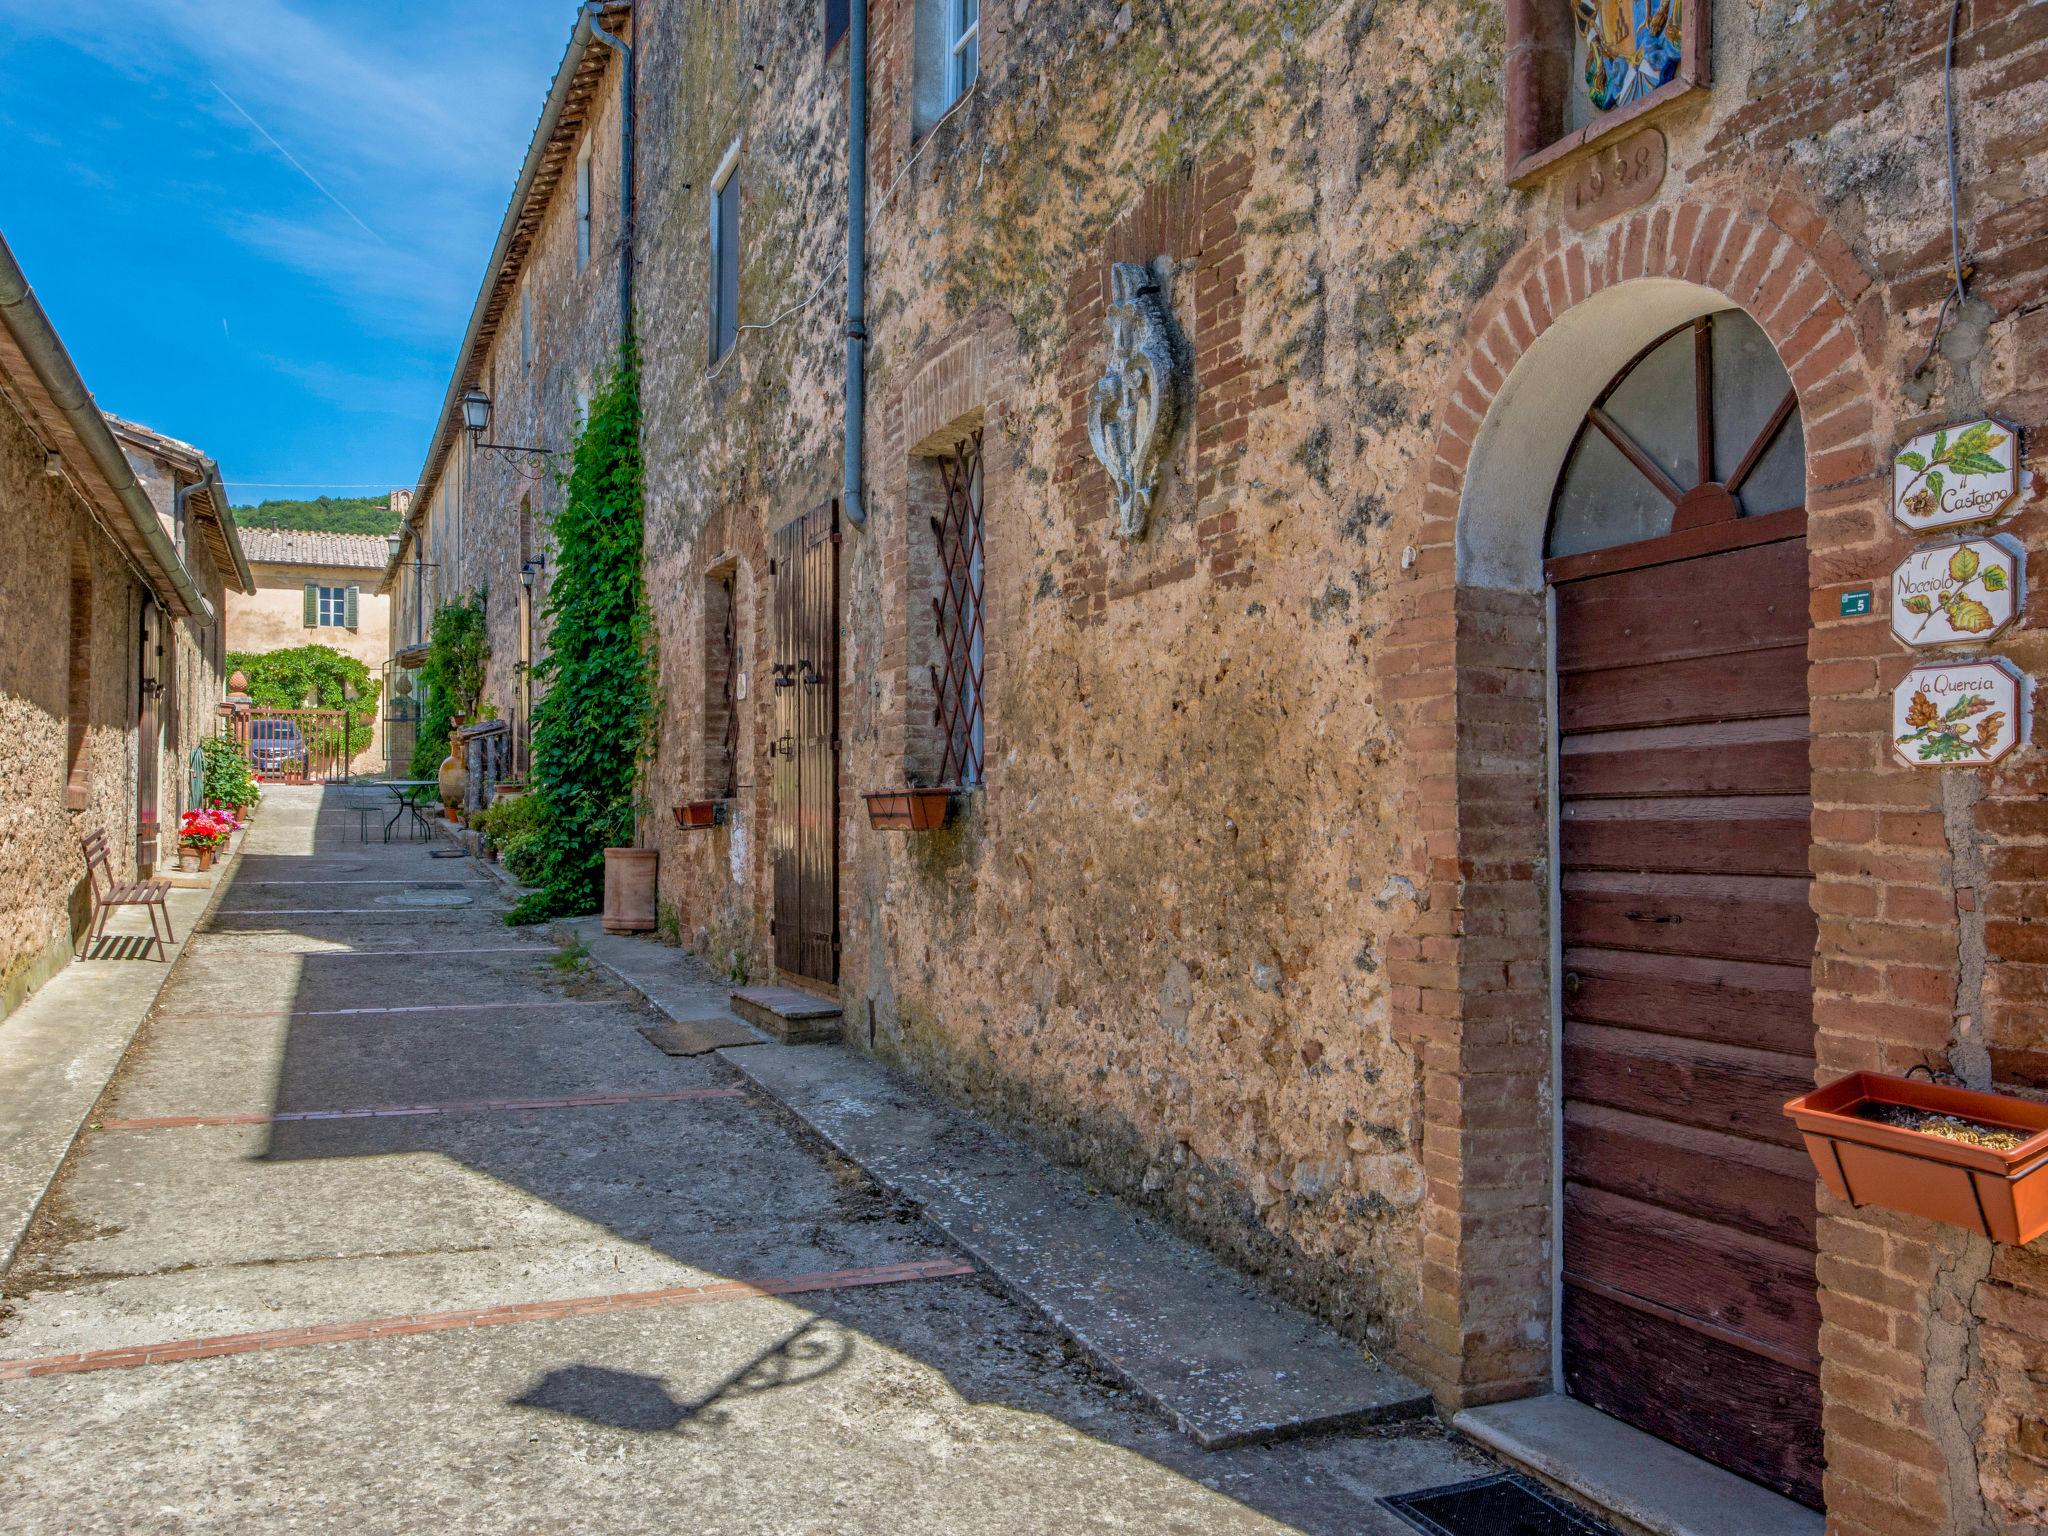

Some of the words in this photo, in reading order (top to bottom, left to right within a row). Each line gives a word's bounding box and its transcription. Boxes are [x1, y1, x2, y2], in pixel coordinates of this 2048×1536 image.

[1959, 474, 1968, 490] il
[1940, 489, 2008, 513] Castagno
[1921, 553, 1933, 571] il
[1898, 570, 1954, 596] Nocciolo
[1857, 600, 1865, 612] 5
[1920, 675, 1931, 693] la
[1934, 674, 1994, 697] Quercia
